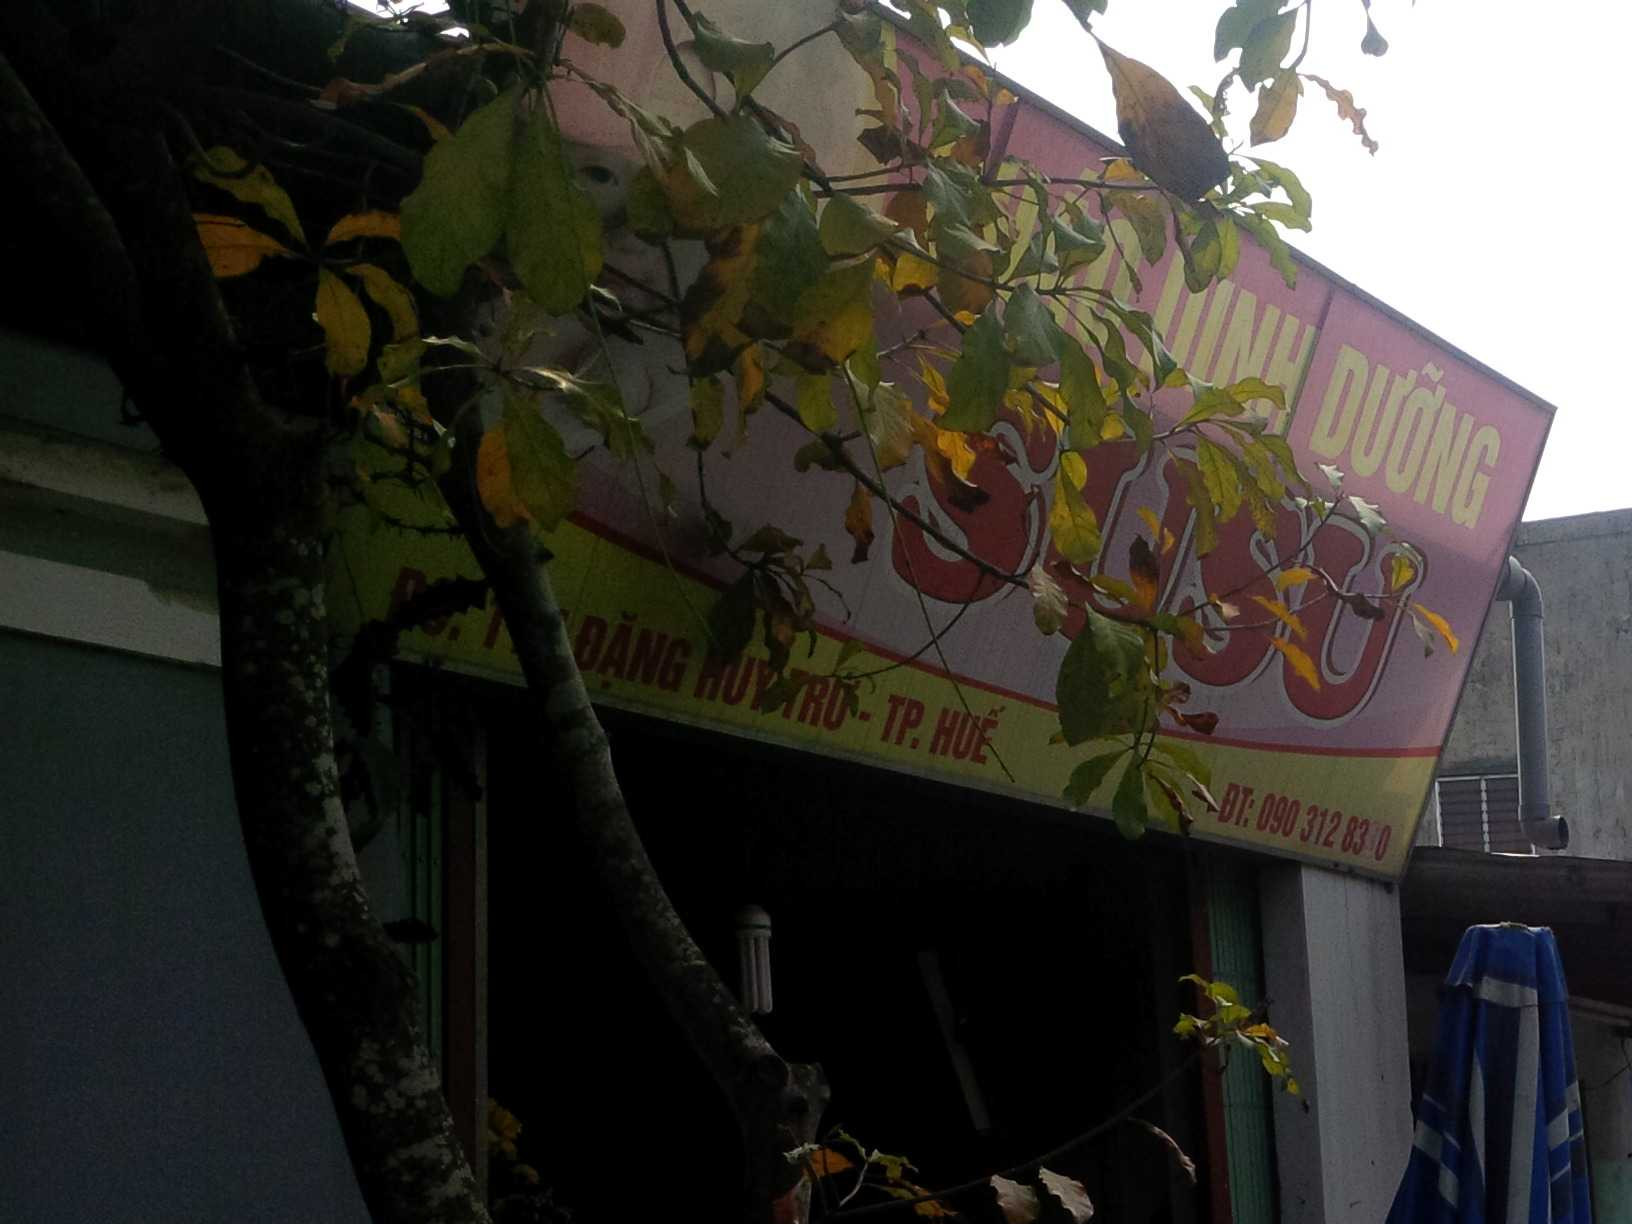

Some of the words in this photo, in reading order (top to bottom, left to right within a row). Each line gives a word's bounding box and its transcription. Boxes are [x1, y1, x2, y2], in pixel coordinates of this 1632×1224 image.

[1309, 342, 1501, 530] DƯỠNG
[881, 694, 925, 750] TP.
[929, 706, 1006, 765] HUẾ
[1256, 793, 1301, 837] 090
[1300, 804, 1343, 848] 312
